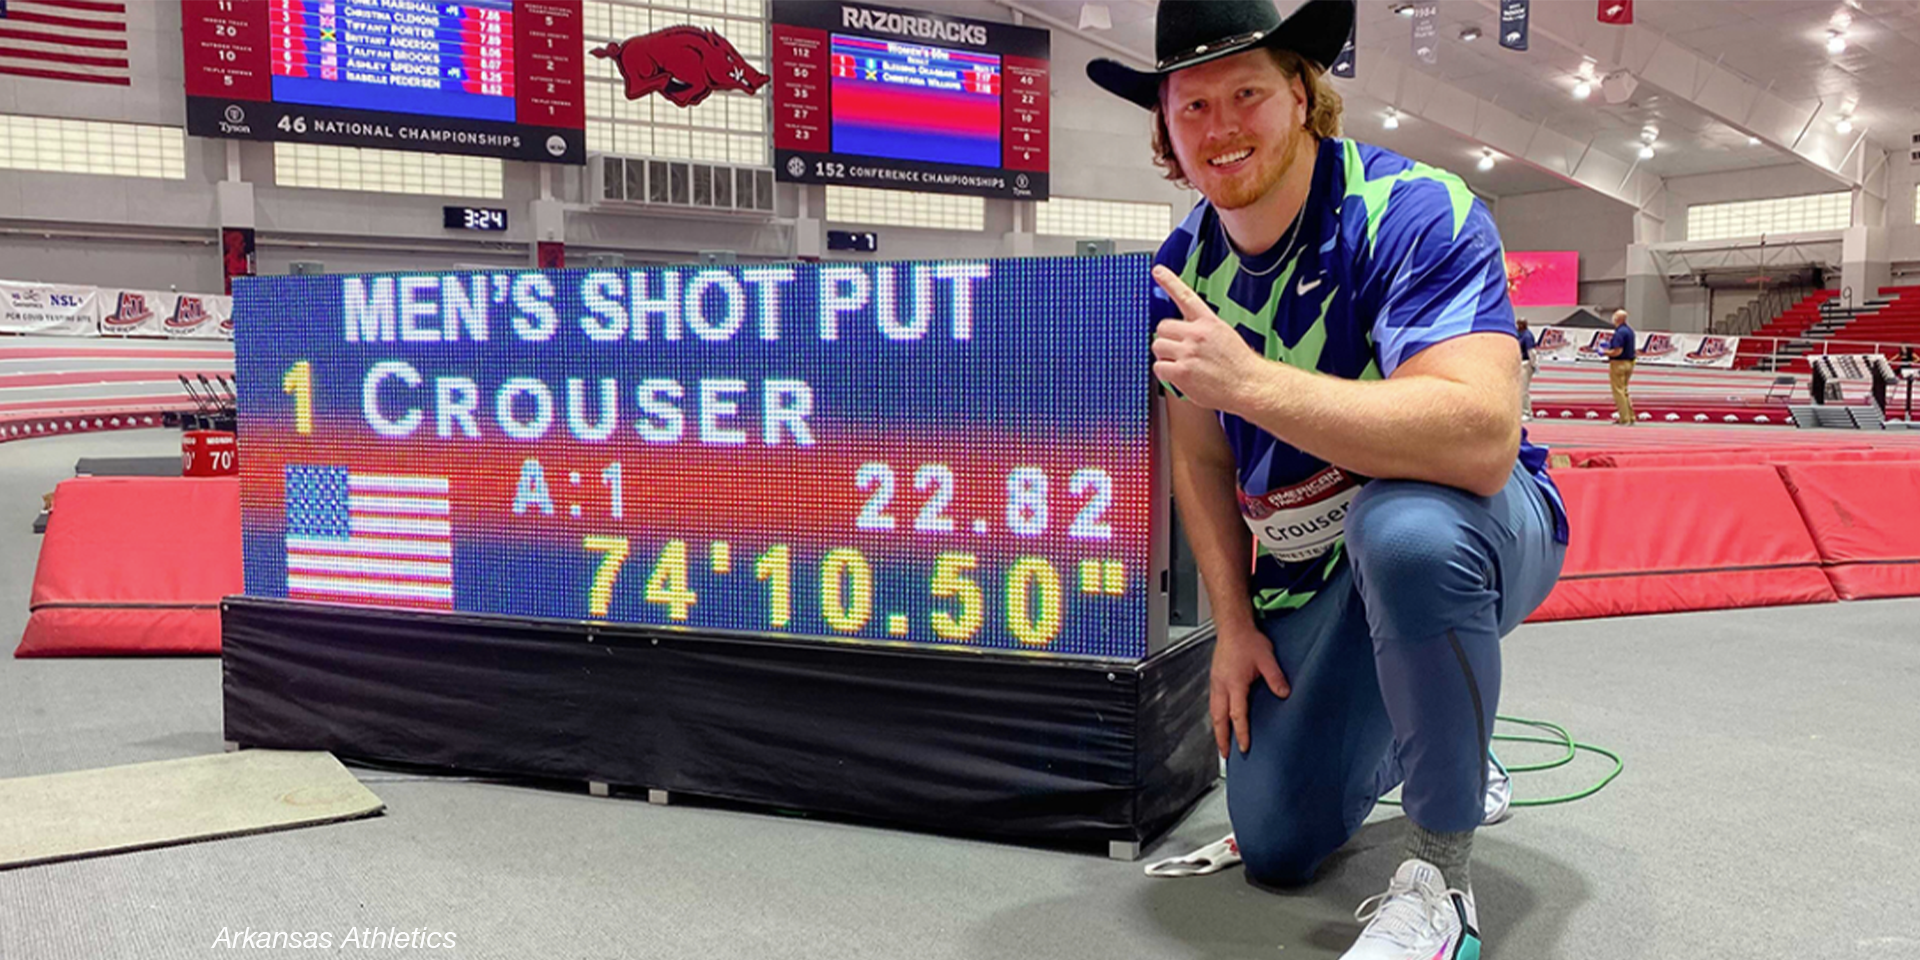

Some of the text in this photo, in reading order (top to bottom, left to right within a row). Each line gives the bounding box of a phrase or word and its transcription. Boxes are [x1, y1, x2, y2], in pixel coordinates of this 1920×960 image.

[215, 24, 237, 37] 20
[842, 6, 987, 46] RAZORBACKS
[547, 39, 553, 48] 1
[219, 50, 236, 62] 10
[284, 64, 291, 75] 7
[546, 60, 555, 71] 2
[224, 75, 233, 86] 5
[549, 106, 554, 115] 1
[219, 121, 250, 134] Tyson
[278, 115, 521, 148] 46 NATIONAL CHAMPIONSHIPS
[815, 161, 1005, 189] 152 CONFERENCE CHAMPIONSHIPS
[464, 209, 503, 228] 3:24
[342, 264, 990, 343] MEN'S SHOT PUT
[282, 360, 314, 435] 1
[854, 461, 1113, 540] 22.82
[1264, 501, 1349, 541] Crouser
